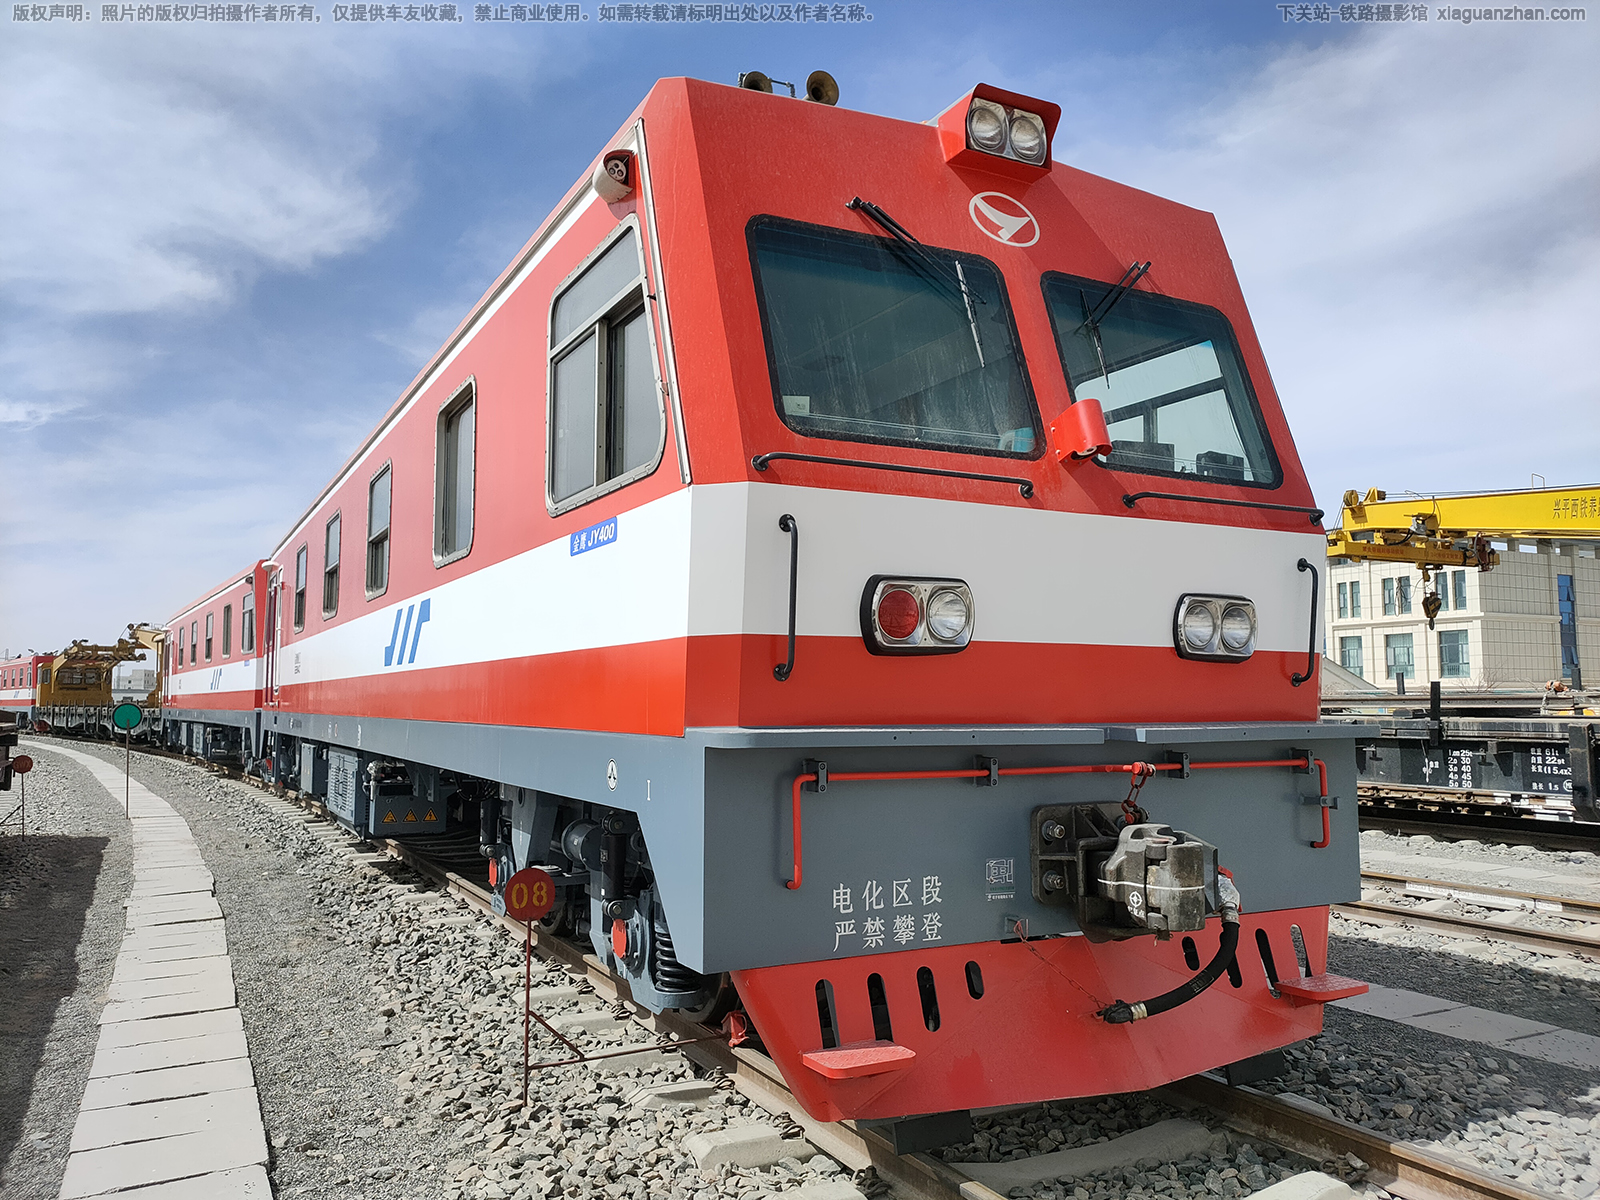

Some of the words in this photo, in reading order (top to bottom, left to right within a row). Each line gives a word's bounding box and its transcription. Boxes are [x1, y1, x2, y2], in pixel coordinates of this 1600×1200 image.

[1552, 496, 1600, 519] 兴平西铁养
[588, 522, 614, 546] JY400
[1461, 764, 1471, 772] 40
[512, 881, 548, 909] 08
[833, 876, 942, 914] 电化区段
[833, 912, 942, 952] 严禁攀登
